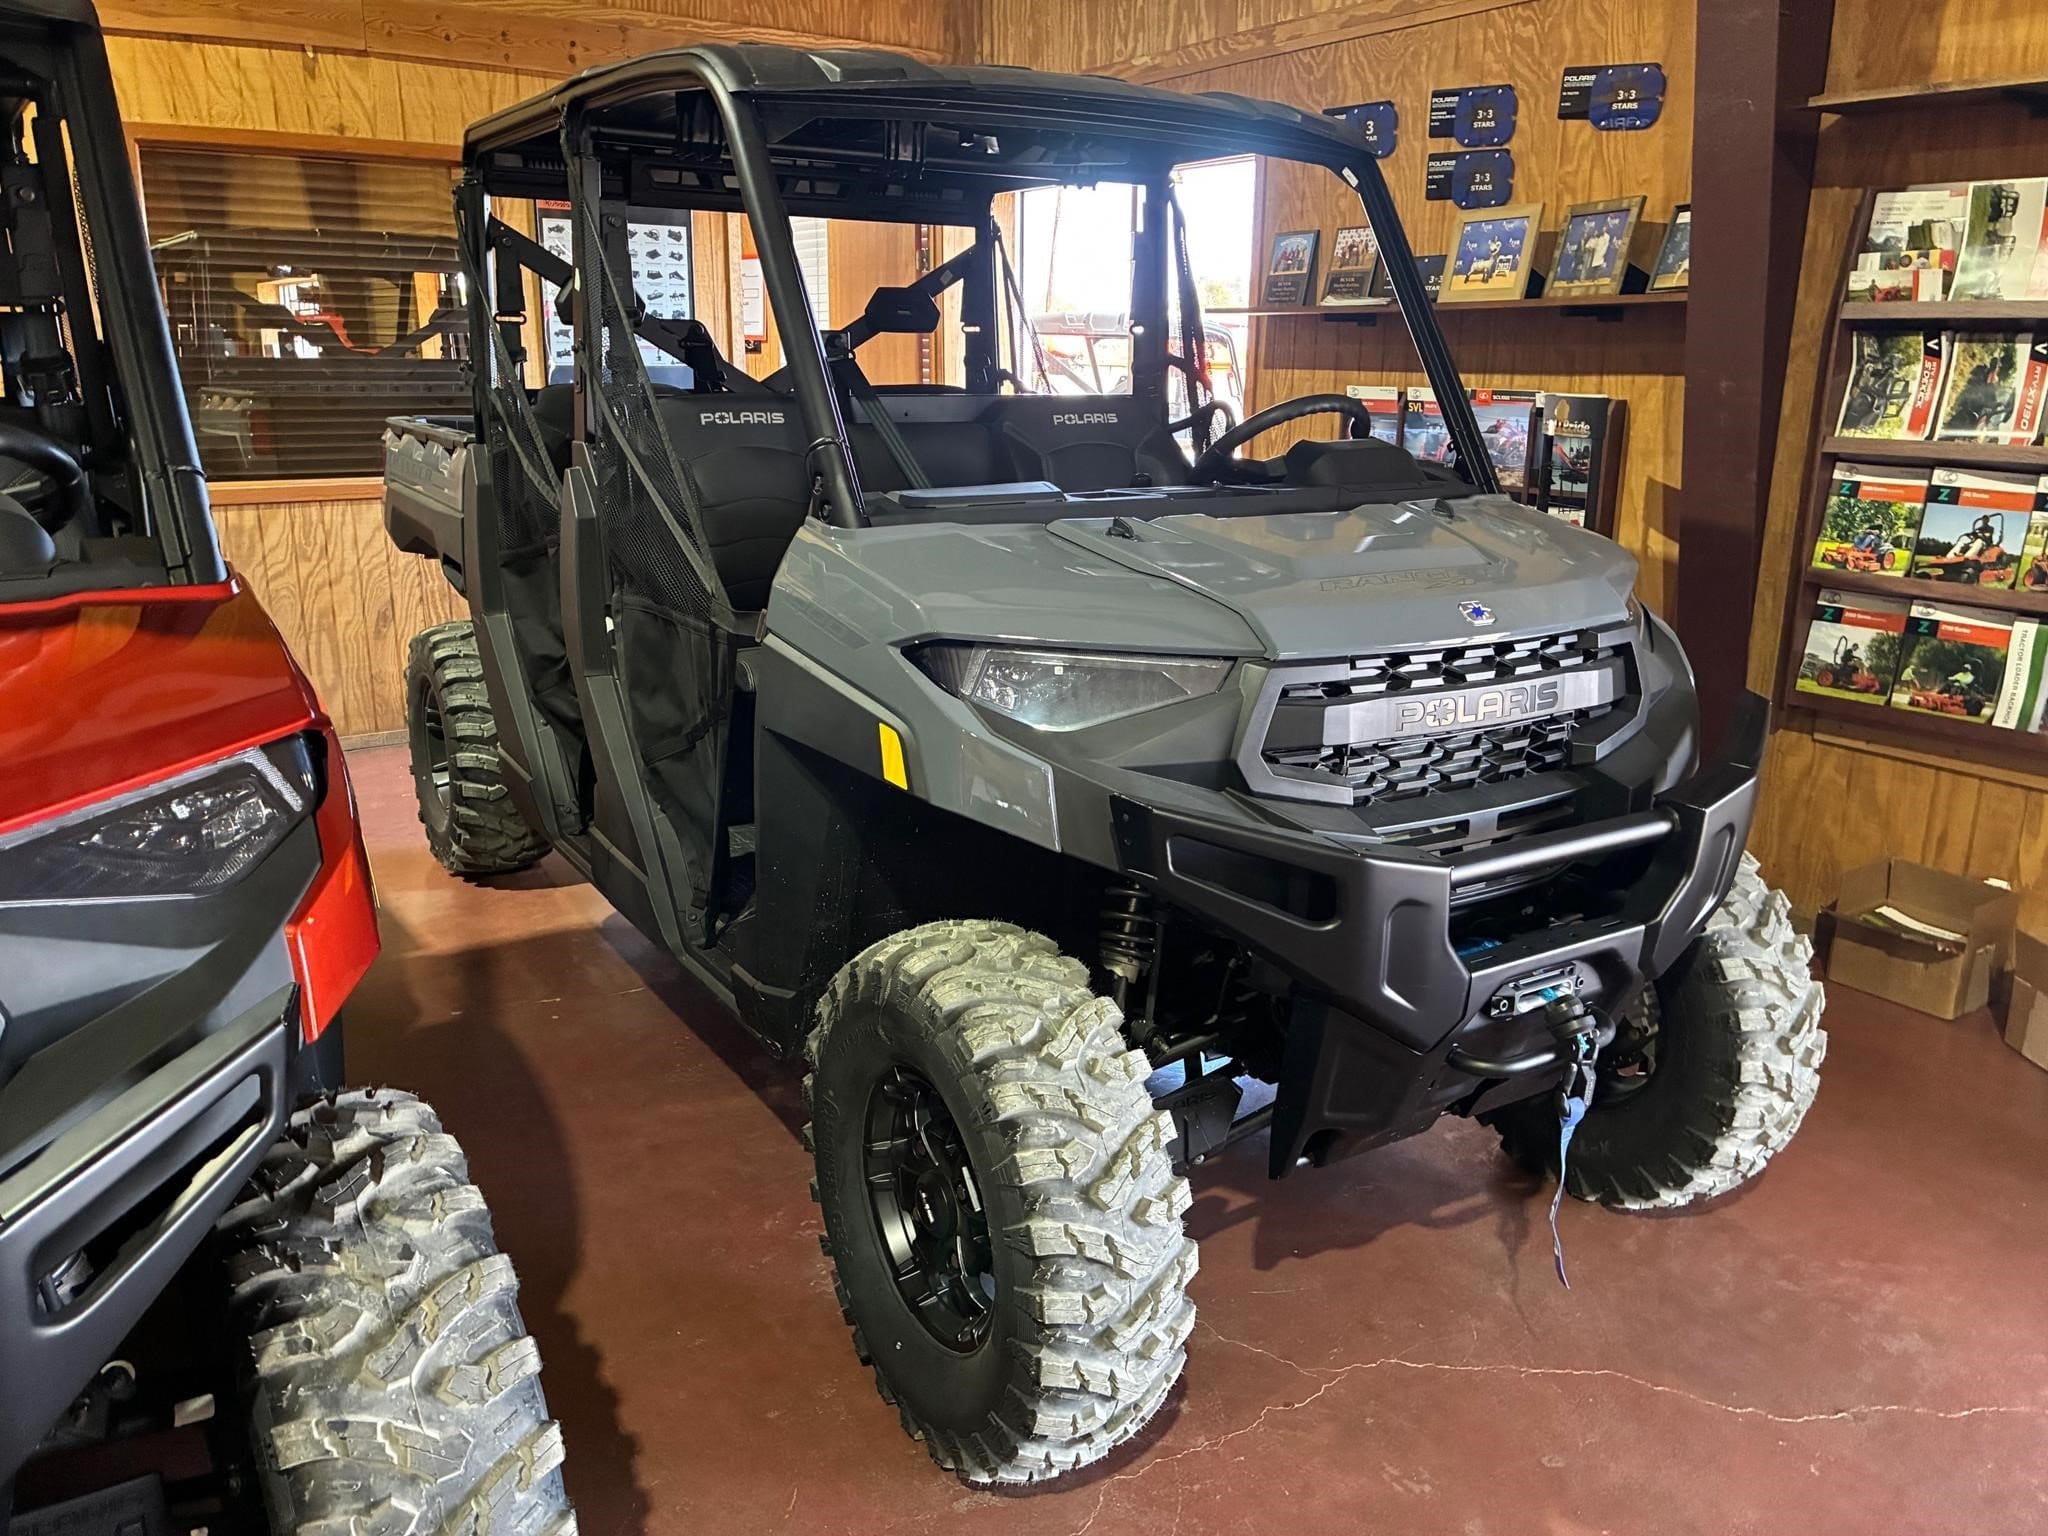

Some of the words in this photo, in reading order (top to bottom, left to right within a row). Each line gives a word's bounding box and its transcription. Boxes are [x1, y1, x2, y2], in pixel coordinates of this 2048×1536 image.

[1563, 74, 1597, 82] POLARIS
[1611, 102, 1639, 110] STARS
[1365, 120, 1375, 134] 3
[1472, 120, 1496, 129] STARS
[1428, 159, 1457, 167] POLARIS
[1470, 184, 1493, 192] STARS
[1408, 401, 1424, 413] SVL
[700, 411, 786, 425] POLARIS
[1052, 412, 1119, 425] POLARIS
[1839, 482, 1853, 495] Z
[1937, 488, 1951, 501] Z
[1822, 607, 1835, 620] Z
[1917, 621, 1930, 633] Z
[1394, 681, 1559, 732] POLARIS
